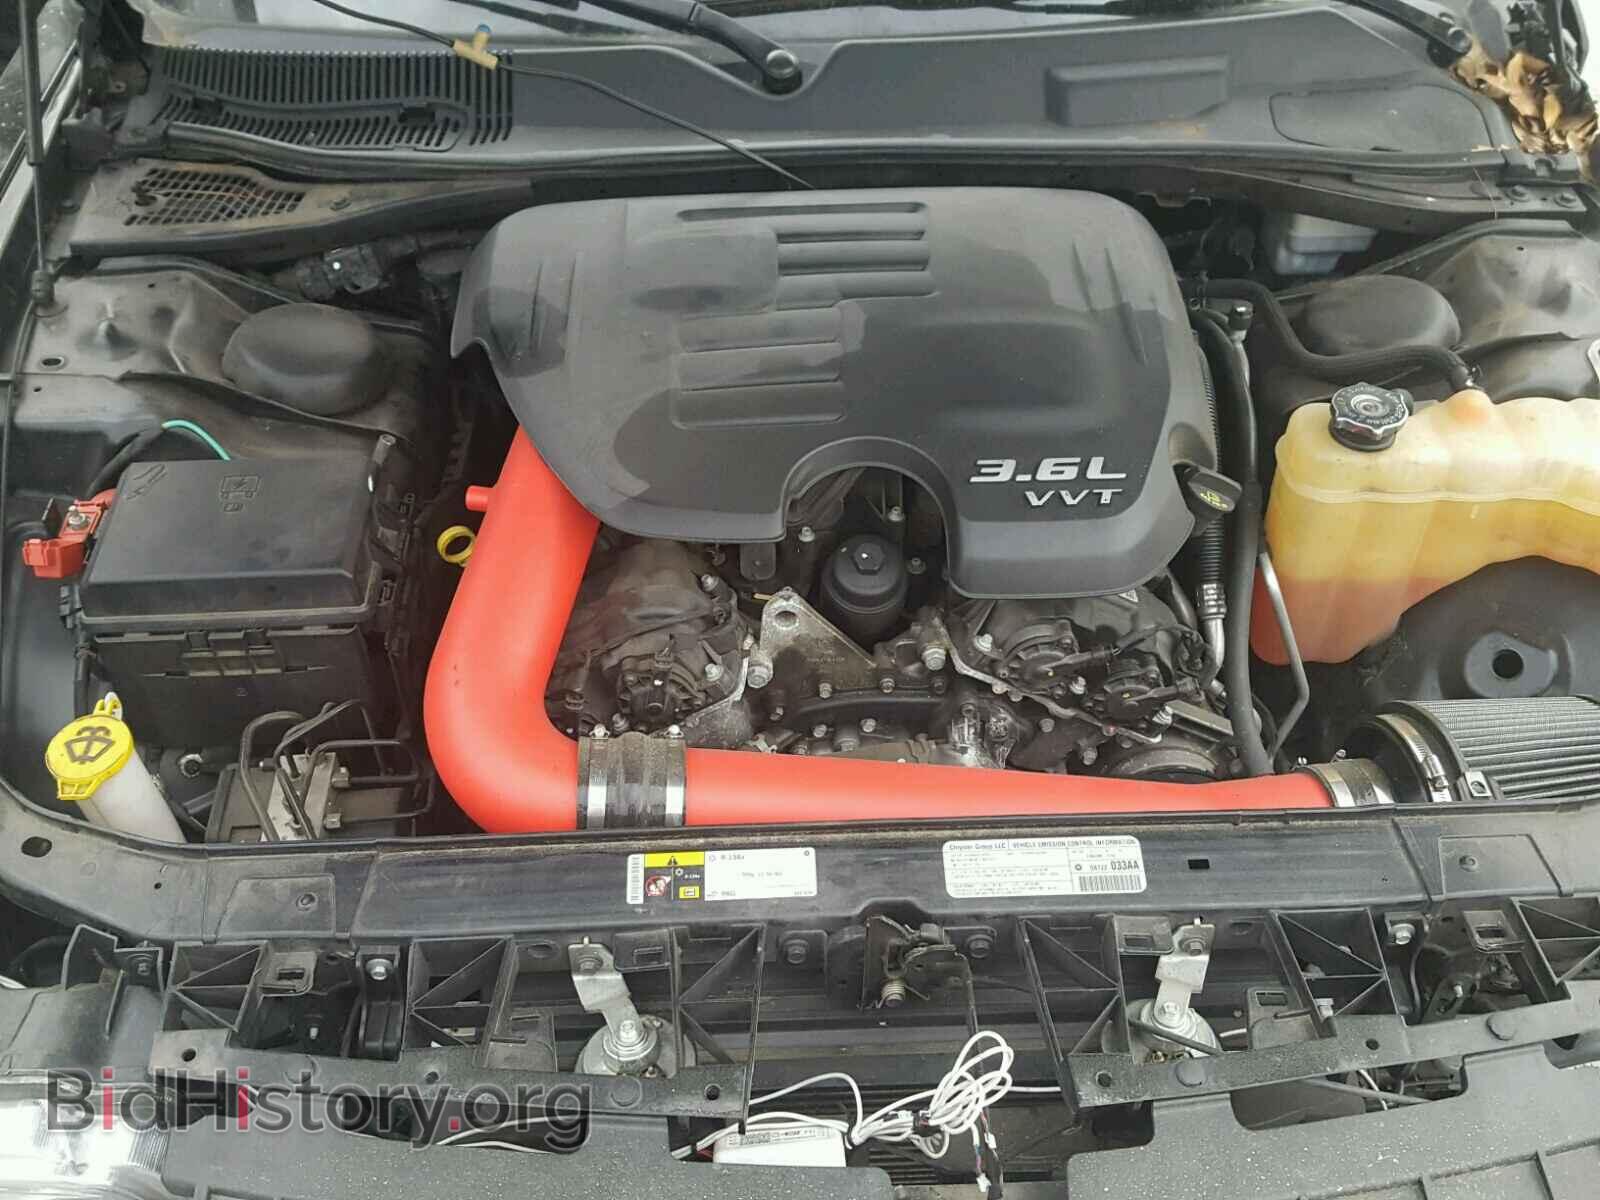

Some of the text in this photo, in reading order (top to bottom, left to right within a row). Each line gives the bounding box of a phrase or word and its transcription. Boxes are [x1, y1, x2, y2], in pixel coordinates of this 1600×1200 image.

[969, 456, 1127, 483] 3.6L
[1024, 488, 1123, 506] VVT
[1038, 840, 1066, 848] EMISSION
[1067, 839, 1093, 847] CONTROL
[1110, 860, 1140, 871] 033AA
